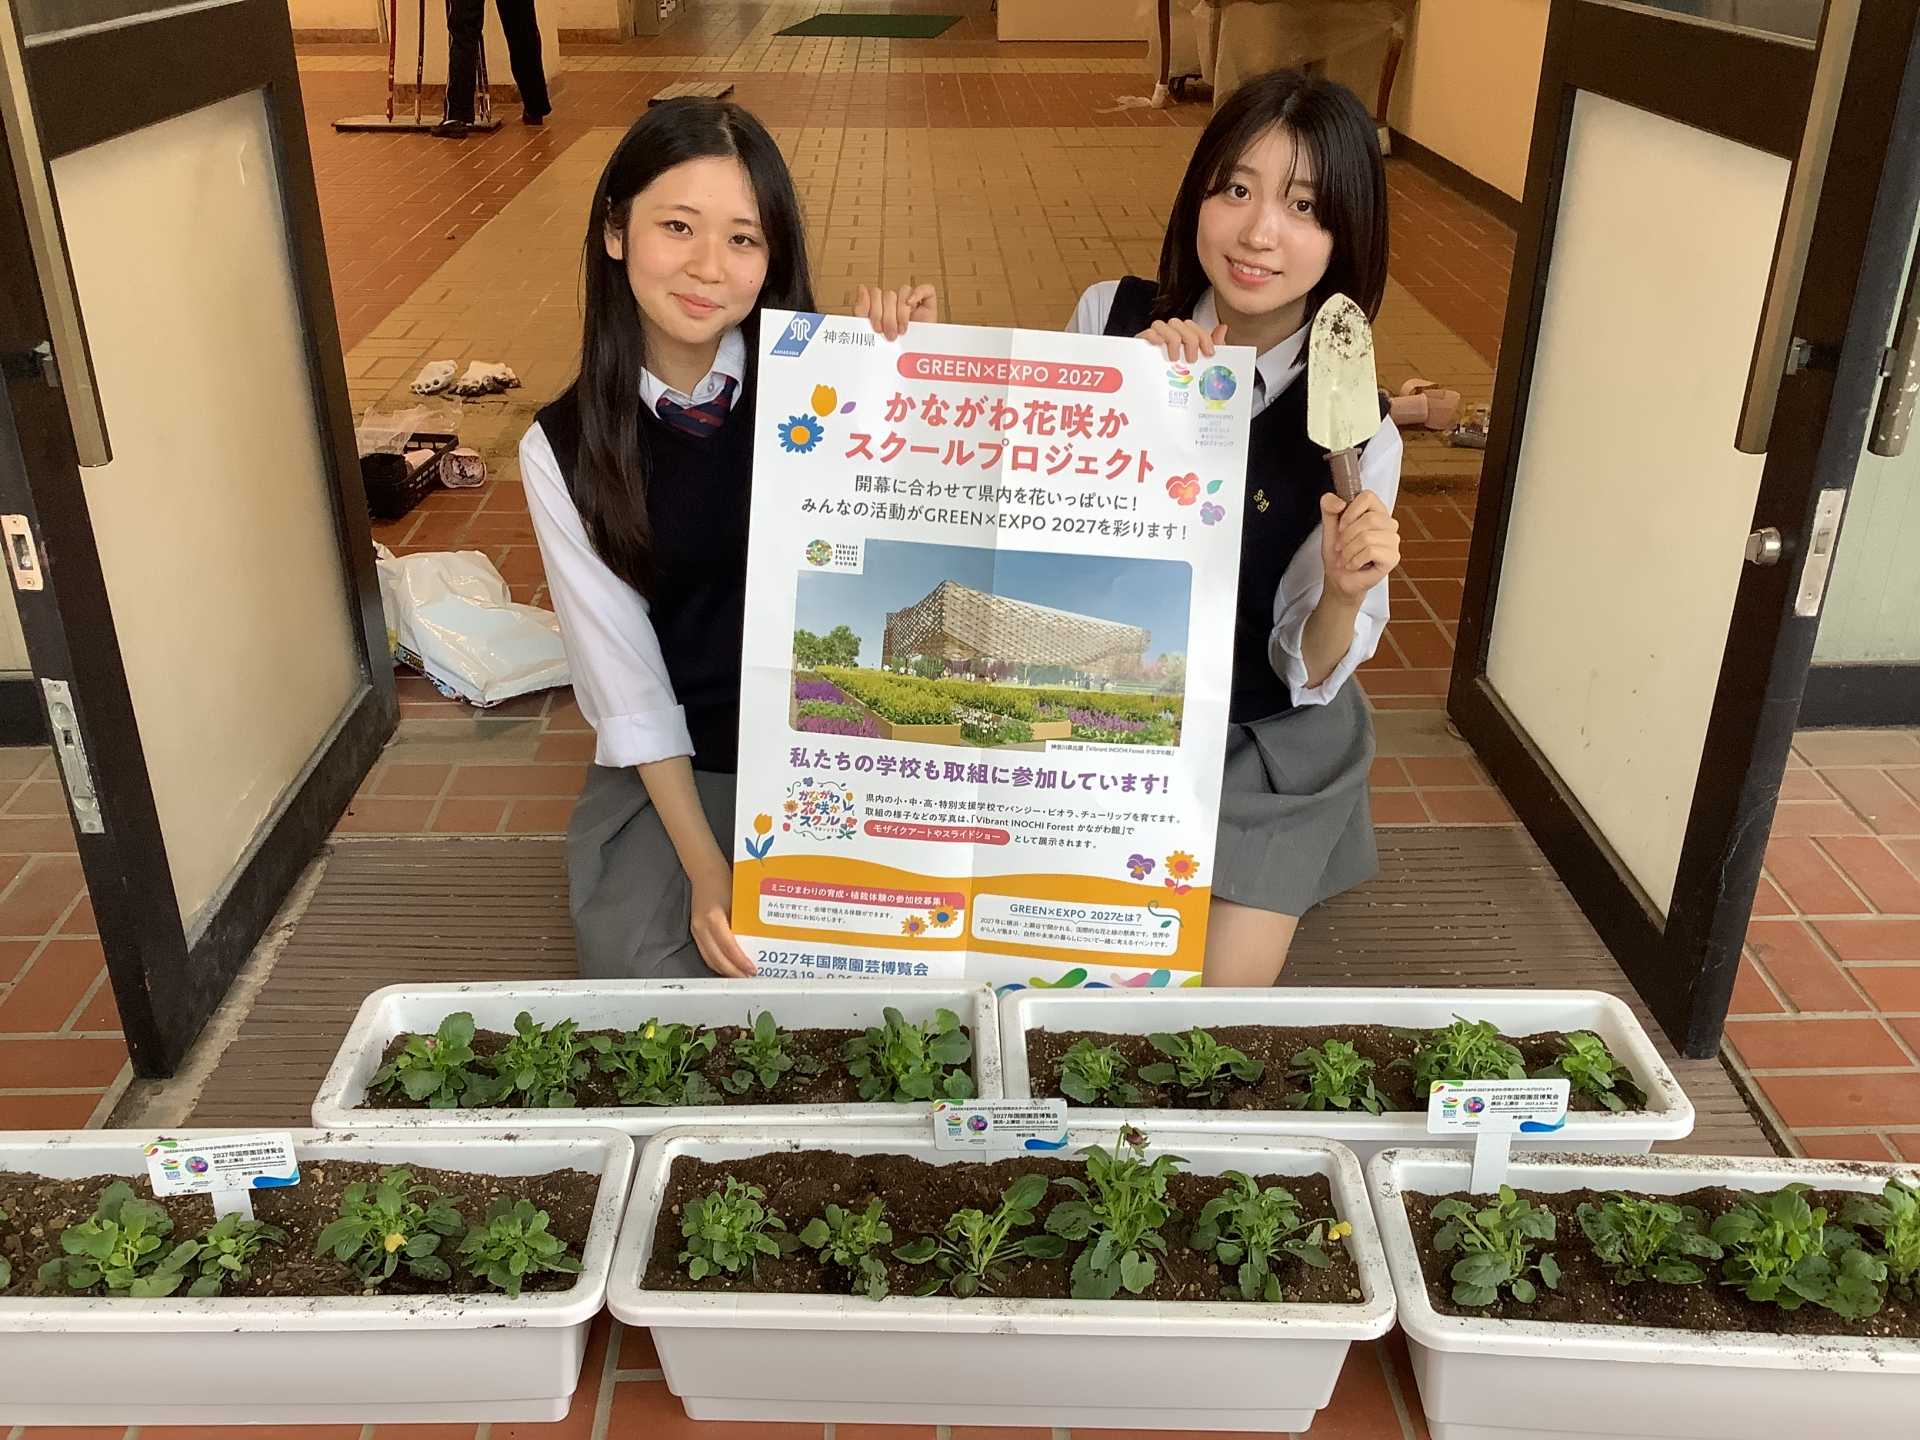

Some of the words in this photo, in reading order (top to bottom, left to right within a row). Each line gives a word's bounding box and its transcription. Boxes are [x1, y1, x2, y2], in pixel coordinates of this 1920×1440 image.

[823, 329, 875, 346] 神奈川県
[915, 358, 1049, 382] GREEN×EXPO
[1057, 368, 1105, 387] 2027
[884, 391, 1130, 439] かながわ花咲か
[845, 431, 1154, 483] スクールプロジェクト
[855, 474, 1137, 511] 開幕に合わせて県内を花いっぱいに！
[801, 498, 1046, 530] みんなの活動がGREEN×EXPO
[790, 747, 1169, 795] 私たちの学校も取組に参加しています！
[799, 815, 841, 828] スクール
[800, 800, 840, 816] 花咲か
[872, 824, 1001, 841] モザイクアートやスライドショー
[1014, 834, 1098, 849] として展示されます。
[1010, 819, 1045, 830] INOCHI
[1046, 821, 1074, 832] Forest
[1009, 903, 1087, 919] GREEN×EXPO
[757, 949, 930, 977] 2027年国際園芸博覧会
